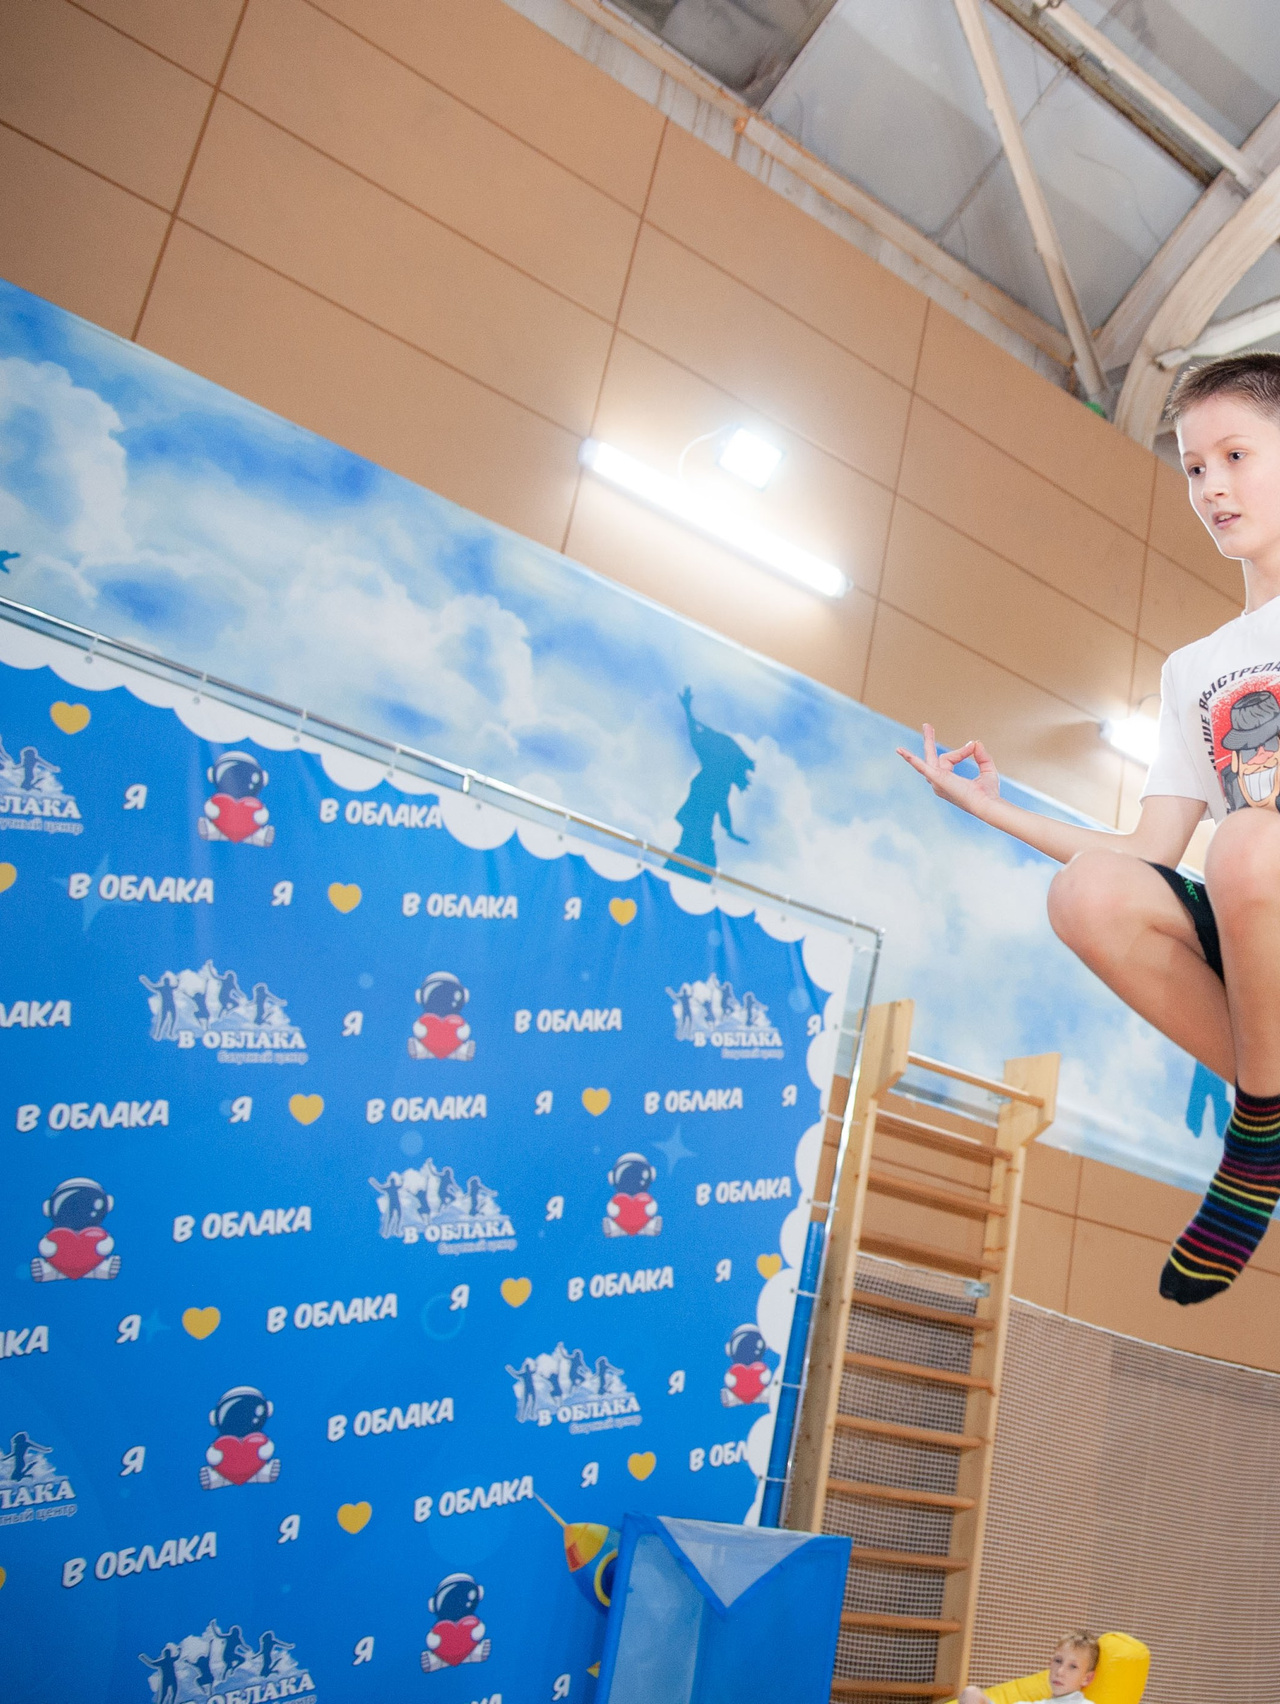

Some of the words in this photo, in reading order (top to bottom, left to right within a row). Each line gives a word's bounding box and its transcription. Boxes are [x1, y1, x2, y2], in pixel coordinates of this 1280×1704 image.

[123, 783, 148, 810] Я
[319, 797, 340, 824] В
[345, 799, 443, 830] ОБЛАКА
[68, 872, 93, 900] В
[98, 873, 214, 904] ОБЛАКА
[271, 880, 294, 907] Я
[402, 892, 422, 917] В
[425, 892, 518, 919] ОБЛАКА
[563, 896, 582, 921] Я
[341, 1010, 364, 1037] Я
[514, 1009, 533, 1034] В
[536, 1007, 623, 1033] ОБЛАКА
[806, 1012, 822, 1037] Я
[176, 1029, 198, 1049] В
[201, 1029, 307, 1050] ОБЛАКА
[692, 1029, 709, 1047] В
[709, 1029, 783, 1049] ОБЛАКА
[229, 1095, 253, 1124] Я
[365, 1098, 386, 1124] В
[390, 1093, 487, 1123] ОБЛАКА
[534, 1090, 554, 1115] Я
[643, 1091, 661, 1115] В
[664, 1087, 744, 1113] ОБЛАКА
[781, 1084, 798, 1107] Я
[16, 1103, 41, 1133] В
[47, 1099, 169, 1131] ОБЛАКА
[545, 1195, 565, 1222] Я
[695, 1182, 712, 1207] В
[714, 1175, 792, 1204] ОБЛАКА
[172, 1214, 196, 1243] В
[201, 1205, 312, 1240] ОБЛАКА
[401, 1225, 421, 1244] В
[423, 1216, 517, 1244] ОБЛАКА
[715, 1258, 732, 1283] Я
[449, 1283, 470, 1311] Я
[567, 1276, 586, 1302] В
[589, 1265, 674, 1299] ОБЛАКА
[116, 1314, 142, 1344] Я
[266, 1305, 288, 1333] В
[293, 1292, 398, 1329] ОБЛАКА
[667, 1369, 686, 1395] Я
[536, 1407, 554, 1427] В
[554, 1394, 642, 1423] ОБЛАКА
[120, 1445, 146, 1476] Я
[327, 1414, 348, 1442] В
[353, 1397, 454, 1437] ОБЛАКА
[580, 1461, 599, 1488] Я
[689, 1447, 706, 1472] В
[277, 1514, 301, 1544] Я
[413, 1495, 433, 1523] В
[438, 1475, 535, 1517] ОБЛАКА
[62, 1557, 87, 1588] В
[95, 1531, 217, 1580] ОБЛАКА
[352, 1636, 375, 1666] Я
[552, 1673, 571, 1701] Я
